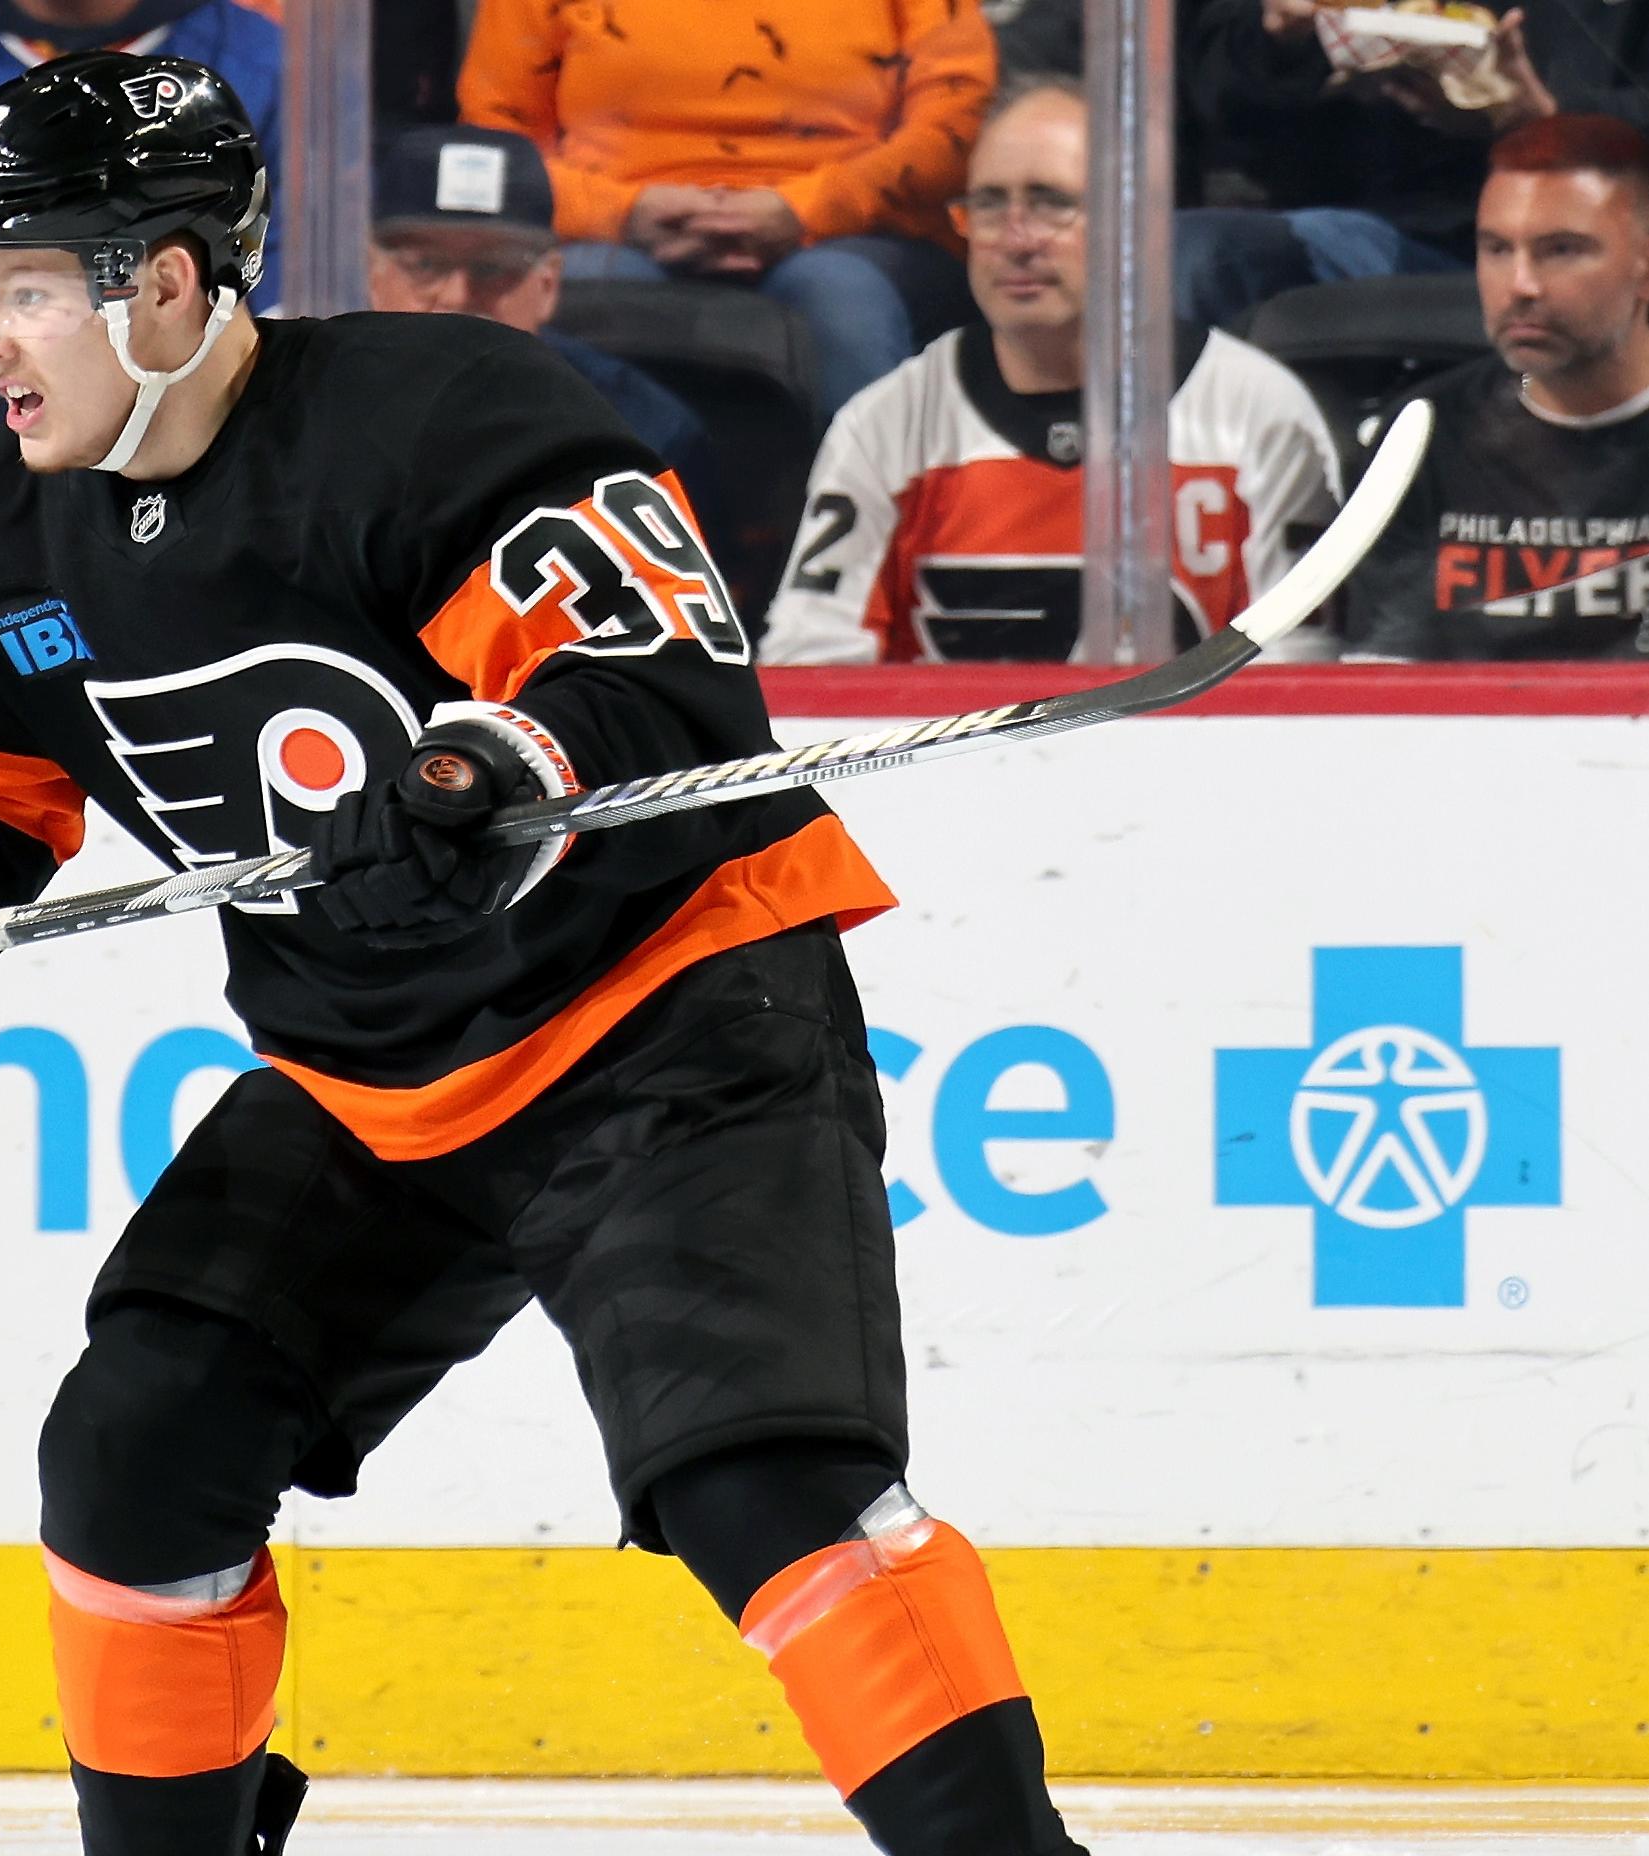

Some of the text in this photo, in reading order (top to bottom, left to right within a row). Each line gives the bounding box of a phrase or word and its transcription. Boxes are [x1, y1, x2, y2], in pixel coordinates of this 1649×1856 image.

[490, 470, 749, 666] 39
[792, 493, 857, 595] 2
[1175, 478, 1230, 576] C
[793, 752, 914, 786] WARRIOR
